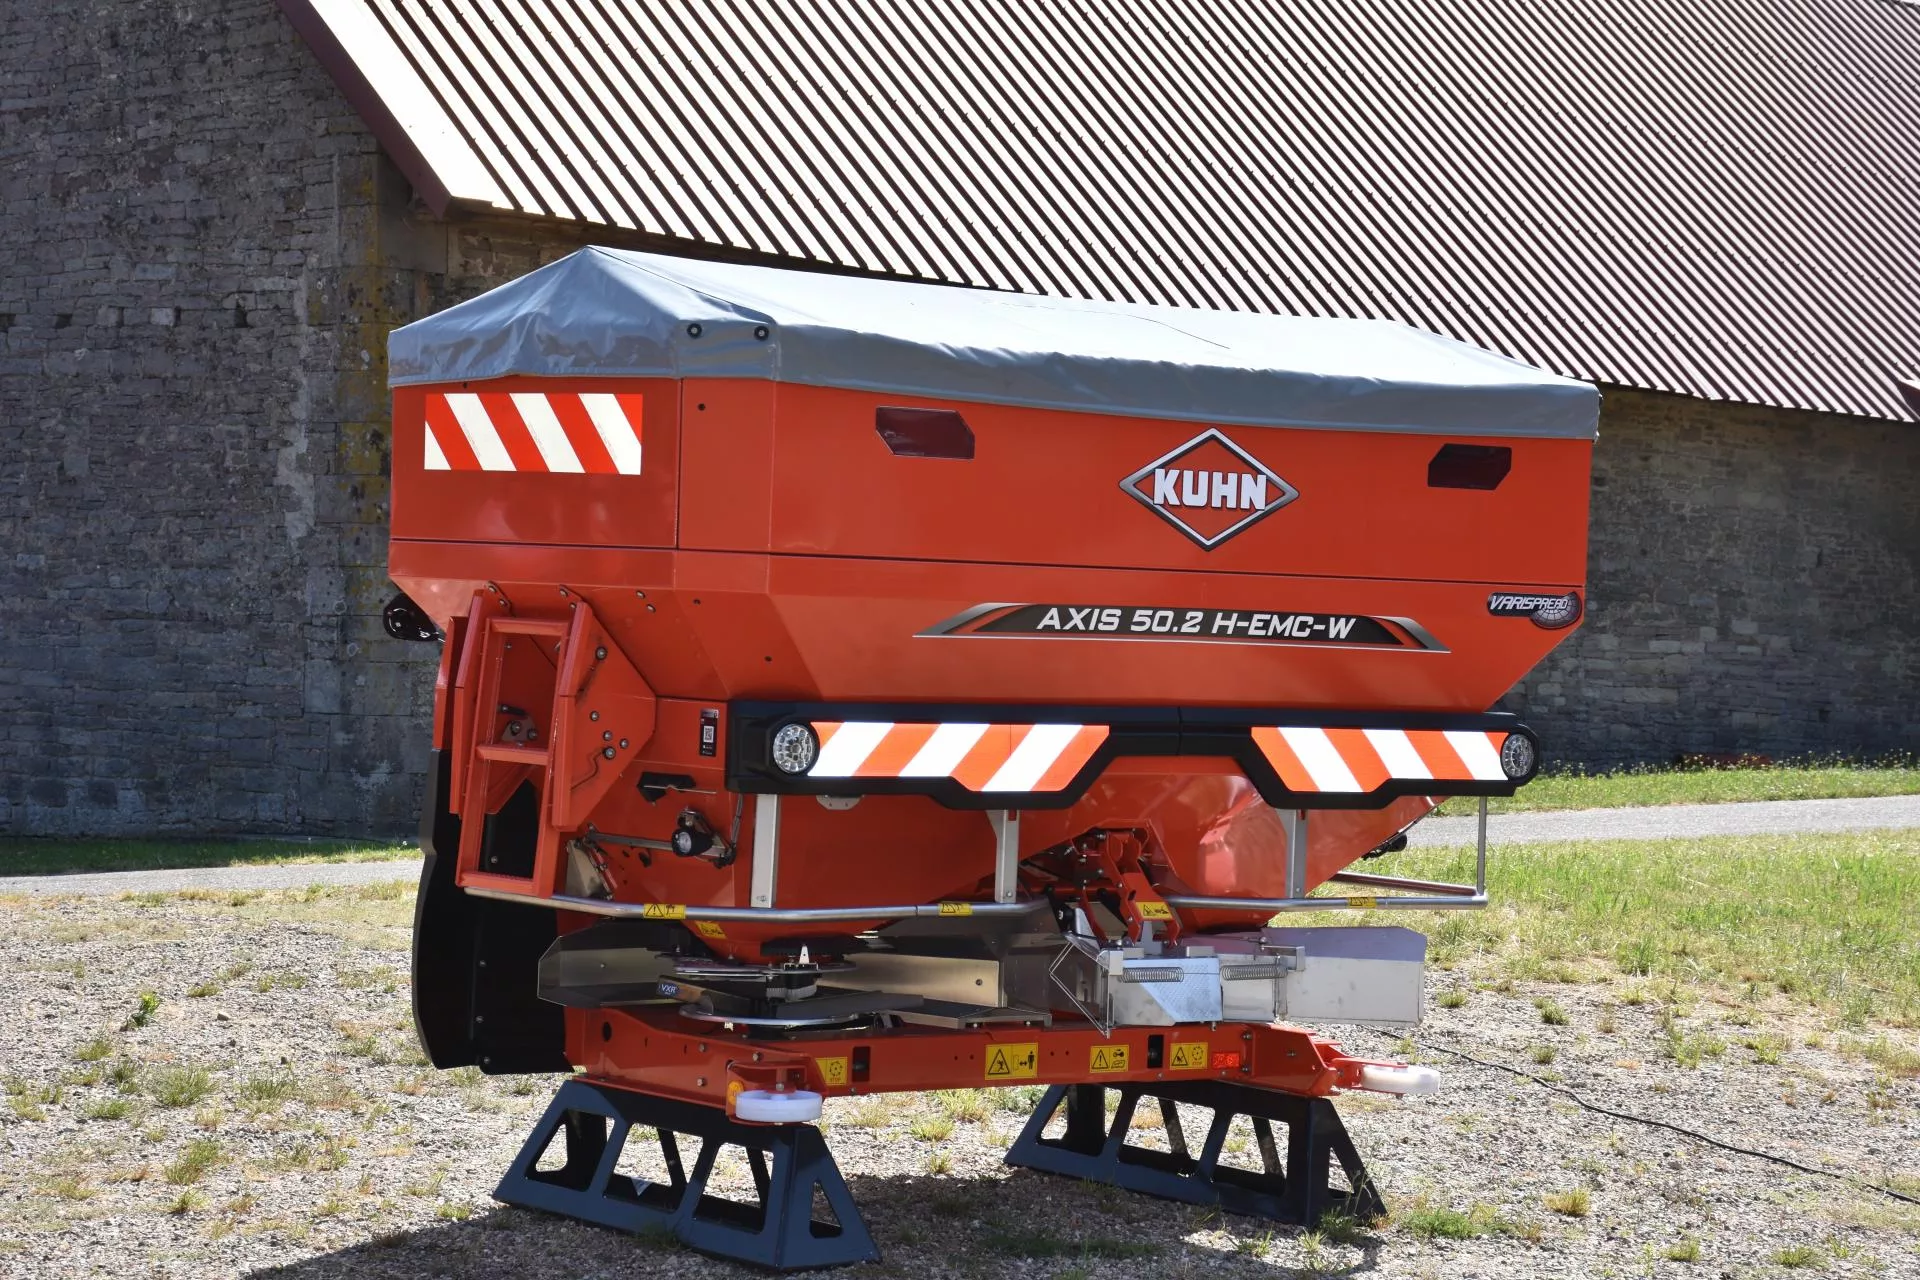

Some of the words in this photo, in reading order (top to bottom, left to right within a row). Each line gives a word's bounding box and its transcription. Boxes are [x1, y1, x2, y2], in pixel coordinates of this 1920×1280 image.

[1153, 468, 1267, 510] KUHN
[1489, 595, 1569, 610] VARISPREAD
[1036, 607, 1122, 631] AXIS
[1130, 609, 1204, 633] 50.2
[1211, 612, 1356, 639] H-EMC-W
